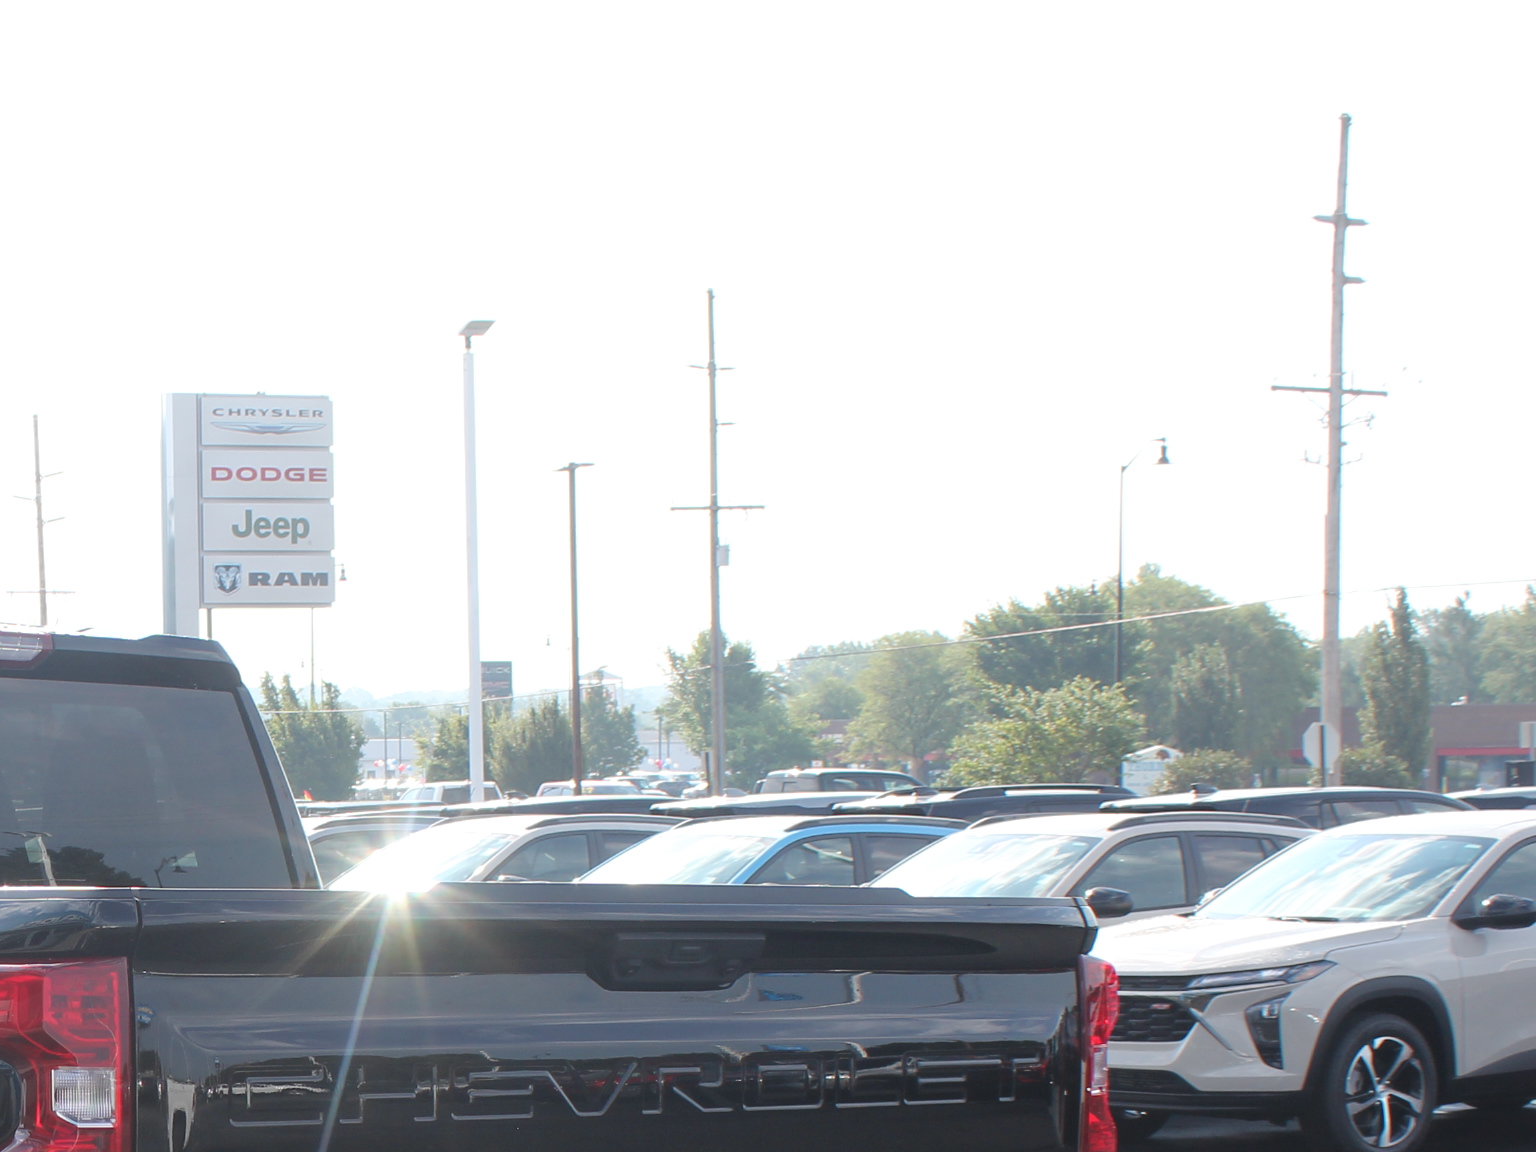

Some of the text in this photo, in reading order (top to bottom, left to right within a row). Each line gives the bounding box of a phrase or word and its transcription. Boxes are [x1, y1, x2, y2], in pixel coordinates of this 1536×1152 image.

[212, 407, 324, 418] CHRYSLER
[210, 467, 328, 482] DODGE
[231, 509, 311, 544] Jeep
[248, 572, 329, 586] RAM
[229, 1050, 1044, 1128] CHEVROLET
